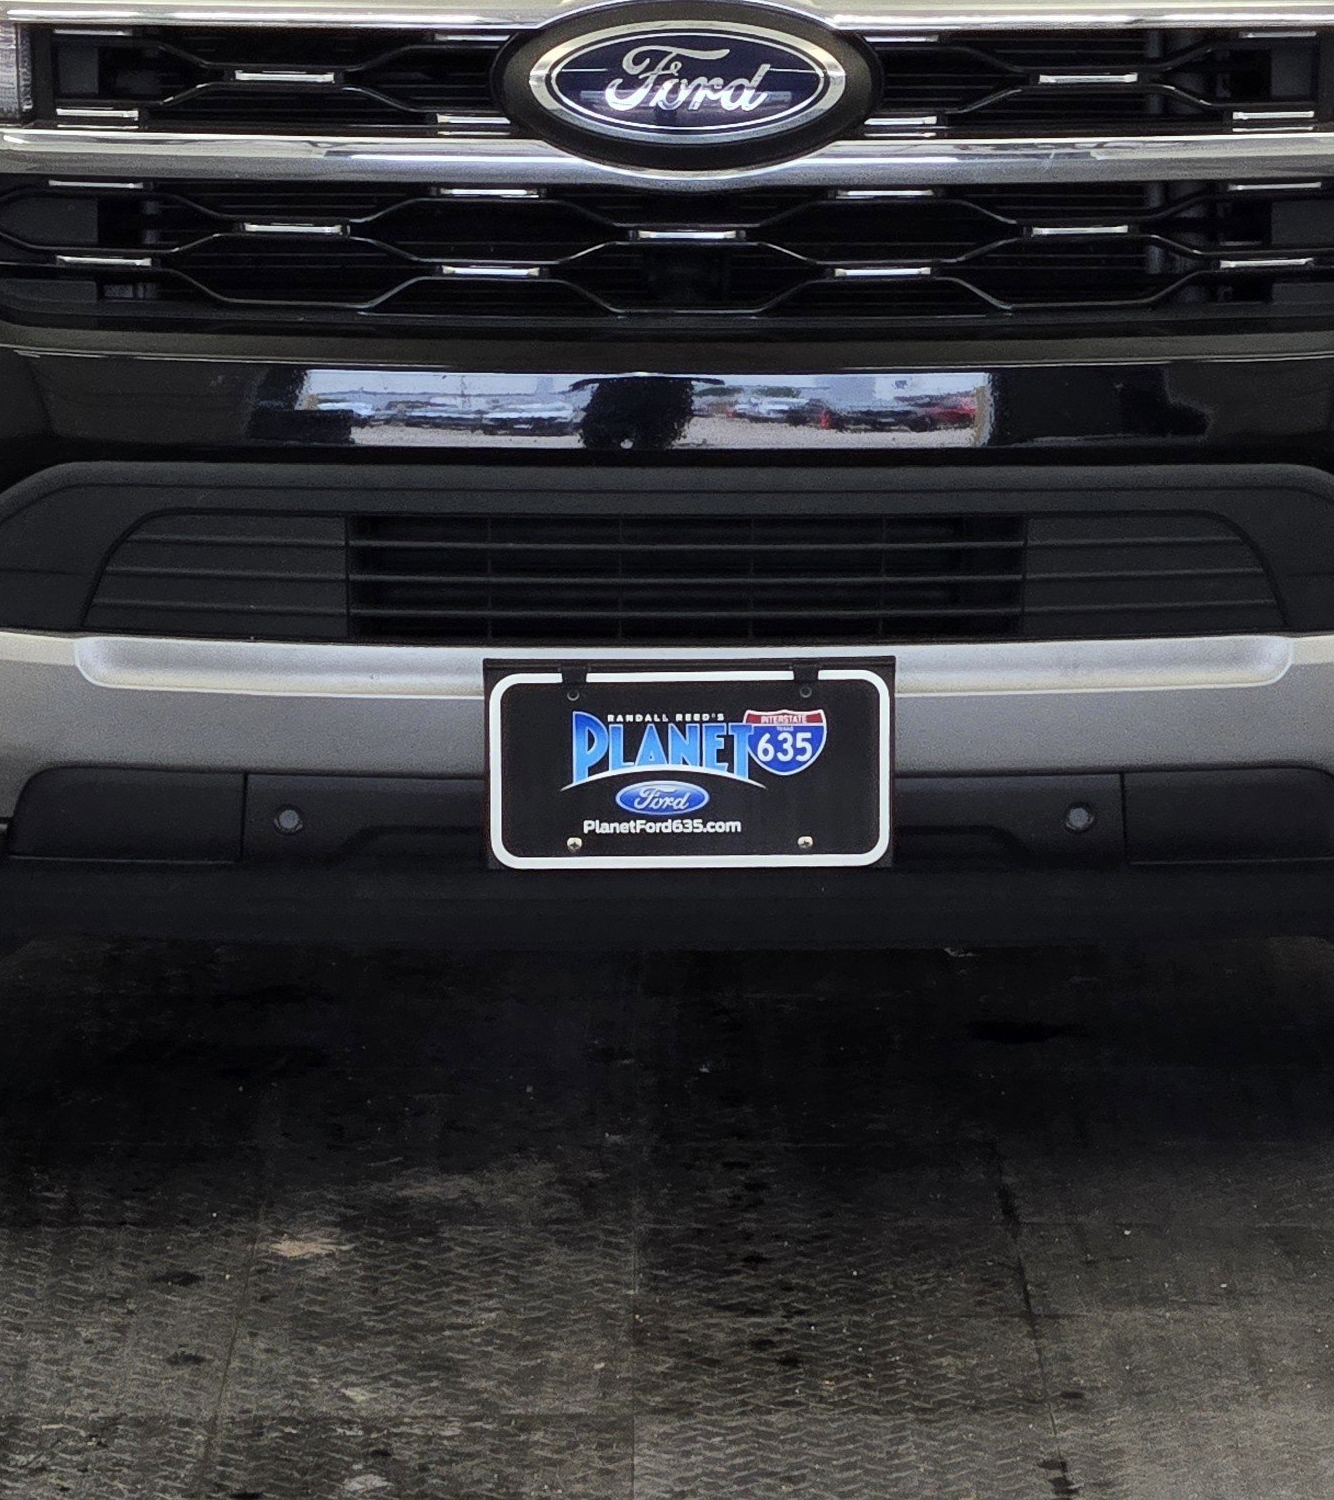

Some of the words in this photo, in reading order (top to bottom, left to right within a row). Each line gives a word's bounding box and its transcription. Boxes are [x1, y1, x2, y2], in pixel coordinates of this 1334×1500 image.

[605, 45, 771, 111] Ford
[607, 714, 669, 723] RANDALL
[572, 711, 755, 784] PLANET
[757, 732, 813, 762] 635
[633, 787, 691, 810] Ford
[583, 818, 742, 834] PlanetFord635.com
